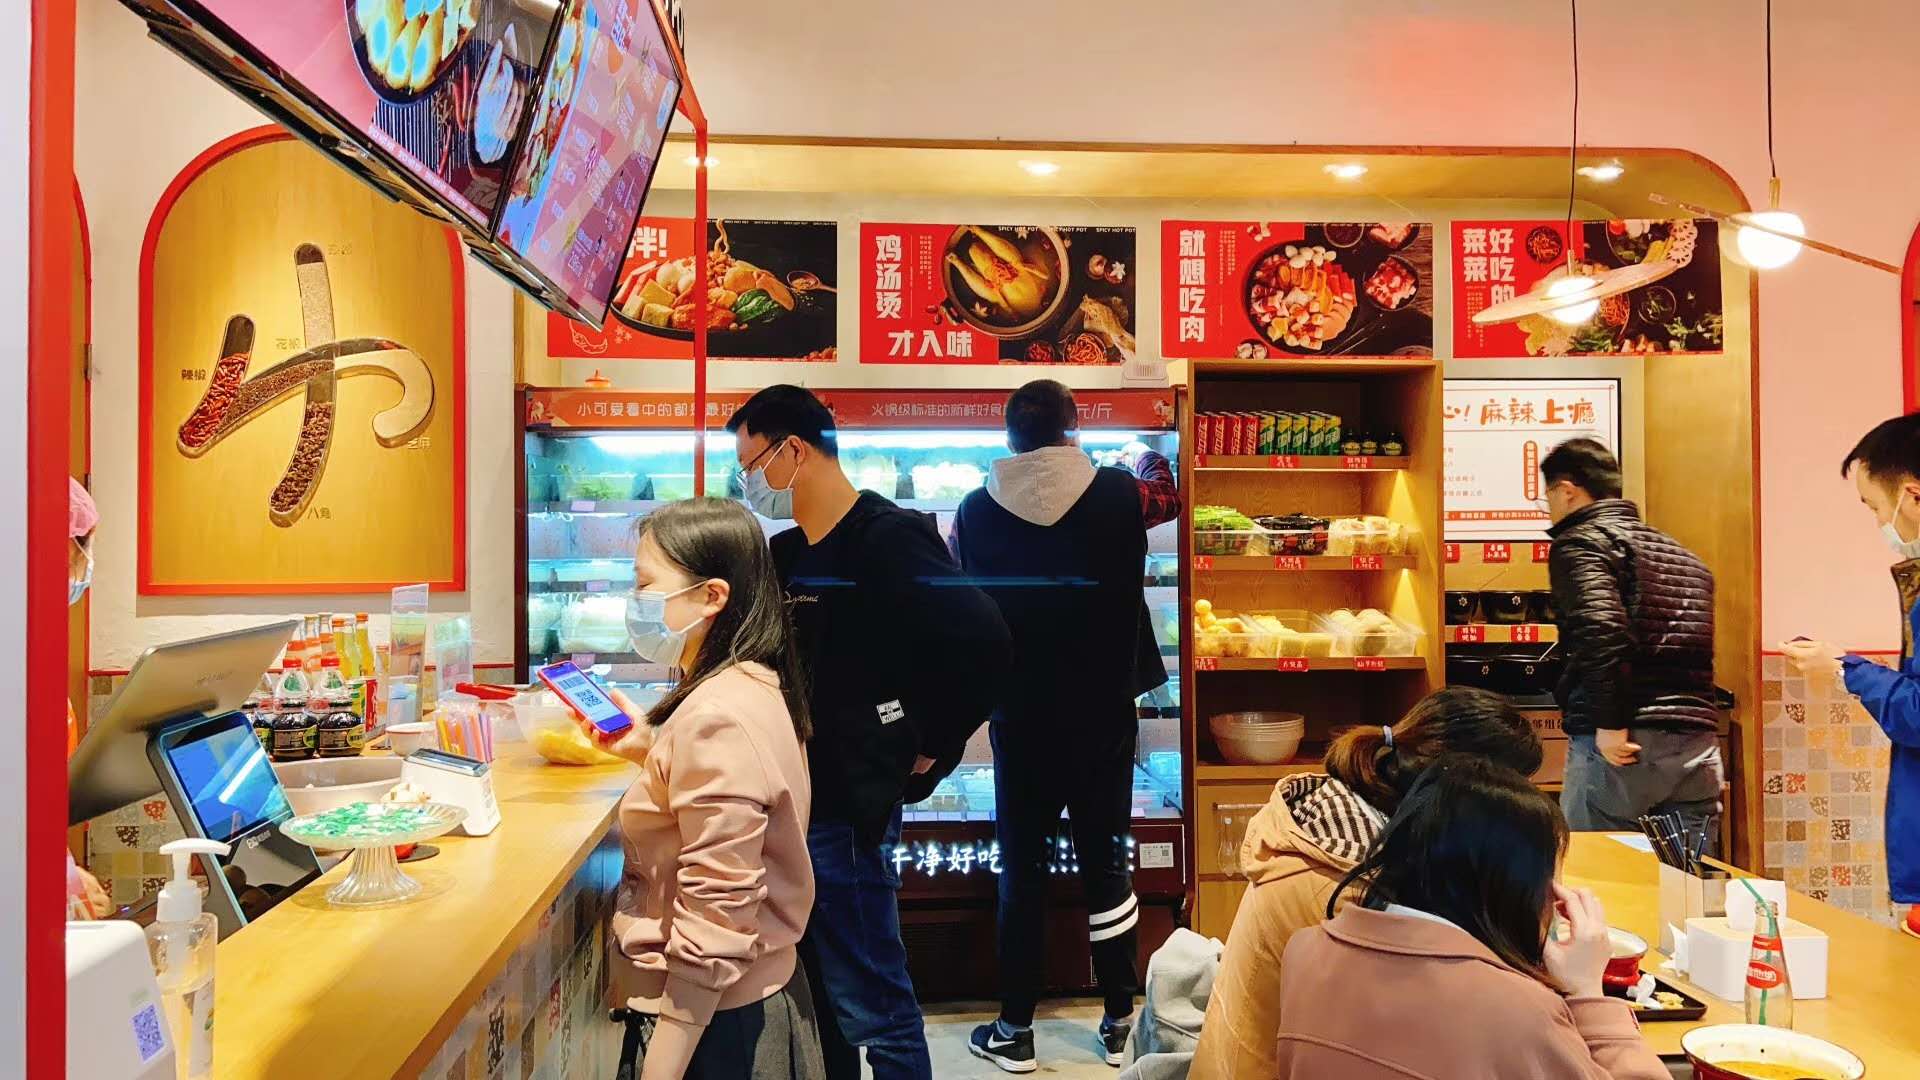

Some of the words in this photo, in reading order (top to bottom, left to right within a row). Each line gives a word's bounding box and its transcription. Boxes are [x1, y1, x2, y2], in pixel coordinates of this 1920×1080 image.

[1463, 228, 1488, 283] 菜菜
[875, 235, 902, 319] 鸡汤烫
[1179, 229, 1206, 343] 就想吃肉
[888, 329, 973, 358] 才入味
[577, 401, 746, 417] 小可爱看中的都最好
[871, 402, 1006, 417] 火锅级标准的新鲜好食
[1480, 397, 1596, 426] 麻辣上瘾
[891, 842, 1003, 877] 干净好吃
